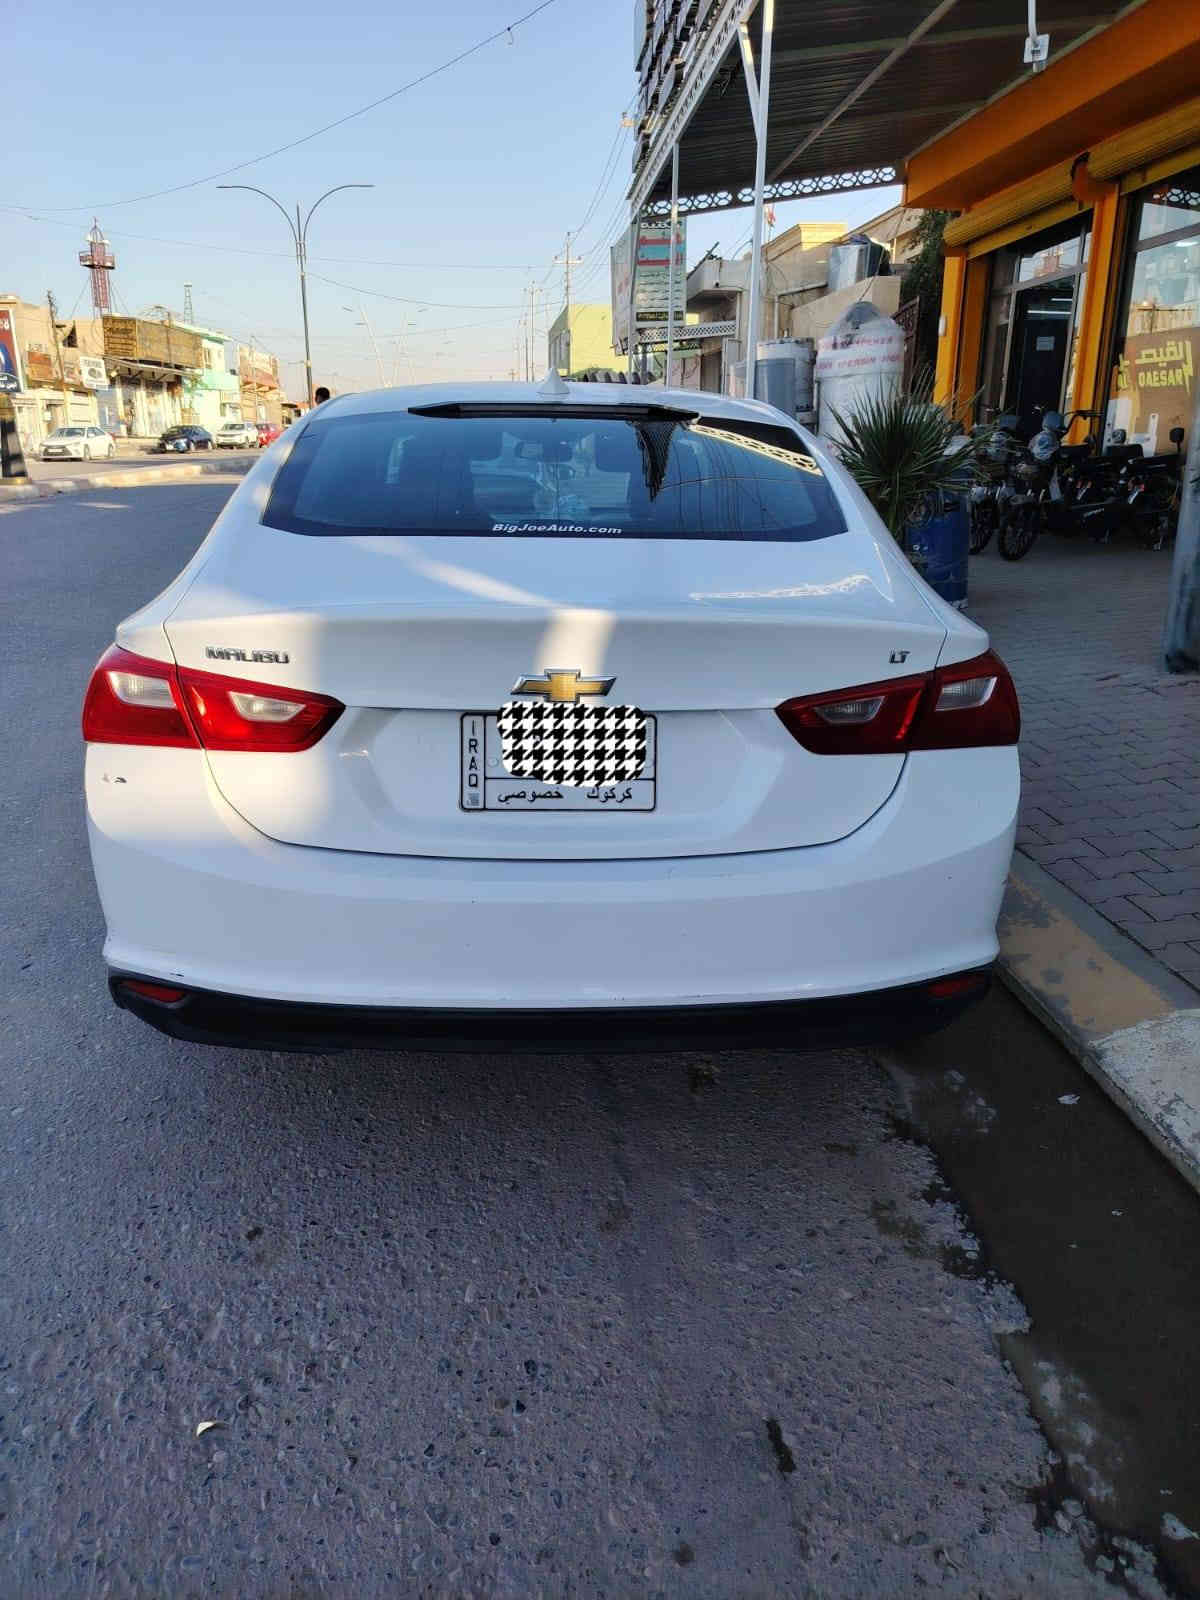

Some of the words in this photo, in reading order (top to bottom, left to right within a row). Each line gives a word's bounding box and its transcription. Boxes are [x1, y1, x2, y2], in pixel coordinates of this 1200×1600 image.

[492, 523, 623, 535] BigJoeAuto.com
[205, 646, 290, 664] MALIBU
[888, 648, 911, 664] LT
[468, 719, 480, 788] IRAQ
[586, 785, 632, 802] كركوك
